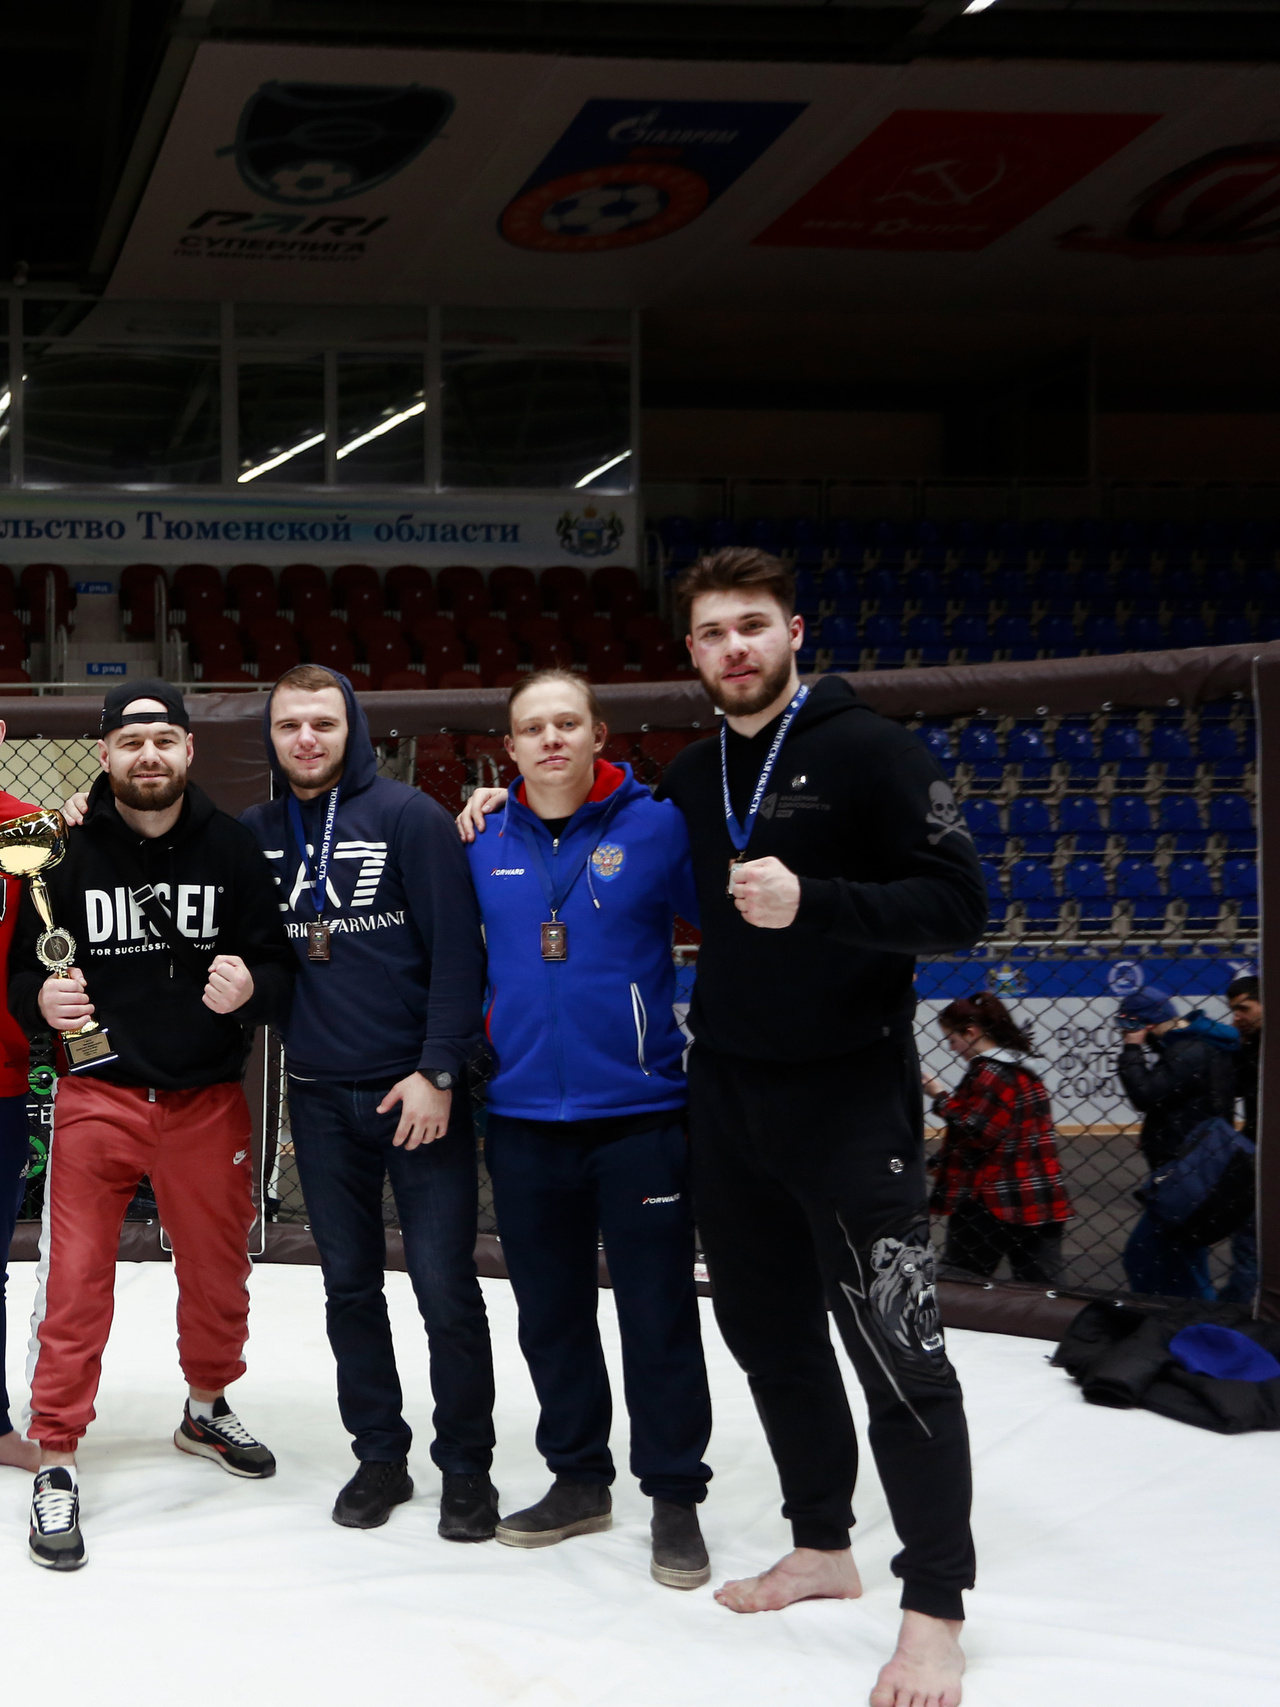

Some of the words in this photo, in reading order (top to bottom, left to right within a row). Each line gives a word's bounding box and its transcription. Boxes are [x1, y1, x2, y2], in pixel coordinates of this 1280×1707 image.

[179, 235, 366, 253] СУПЕРЛИГА
[137, 511, 352, 541] Тюменской
[373, 514, 520, 542] области
[80, 583, 87, 592] 7
[88, 585, 108, 593] ряд
[91, 663, 99, 673] 6
[102, 665, 122, 674] ряд
[763, 714, 793, 772] ТЮМЕНСКАЯ
[749, 772, 769, 815] ОБЛАСТЬ
[323, 787, 339, 841] ТЮМЕНСКАЯ
[318, 843, 330, 881] ОБЛАСТЬ
[490, 868, 525, 876] FORWARD
[338, 911, 405, 934] ARMANI
[90, 948, 111, 956] FOR
[115, 942, 171, 955] SUCCESSF
[1057, 1027, 1123, 1048] РОСС
[1057, 1052, 1121, 1073] ФУТБ
[1058, 1077, 1116, 1098] СОЮ
